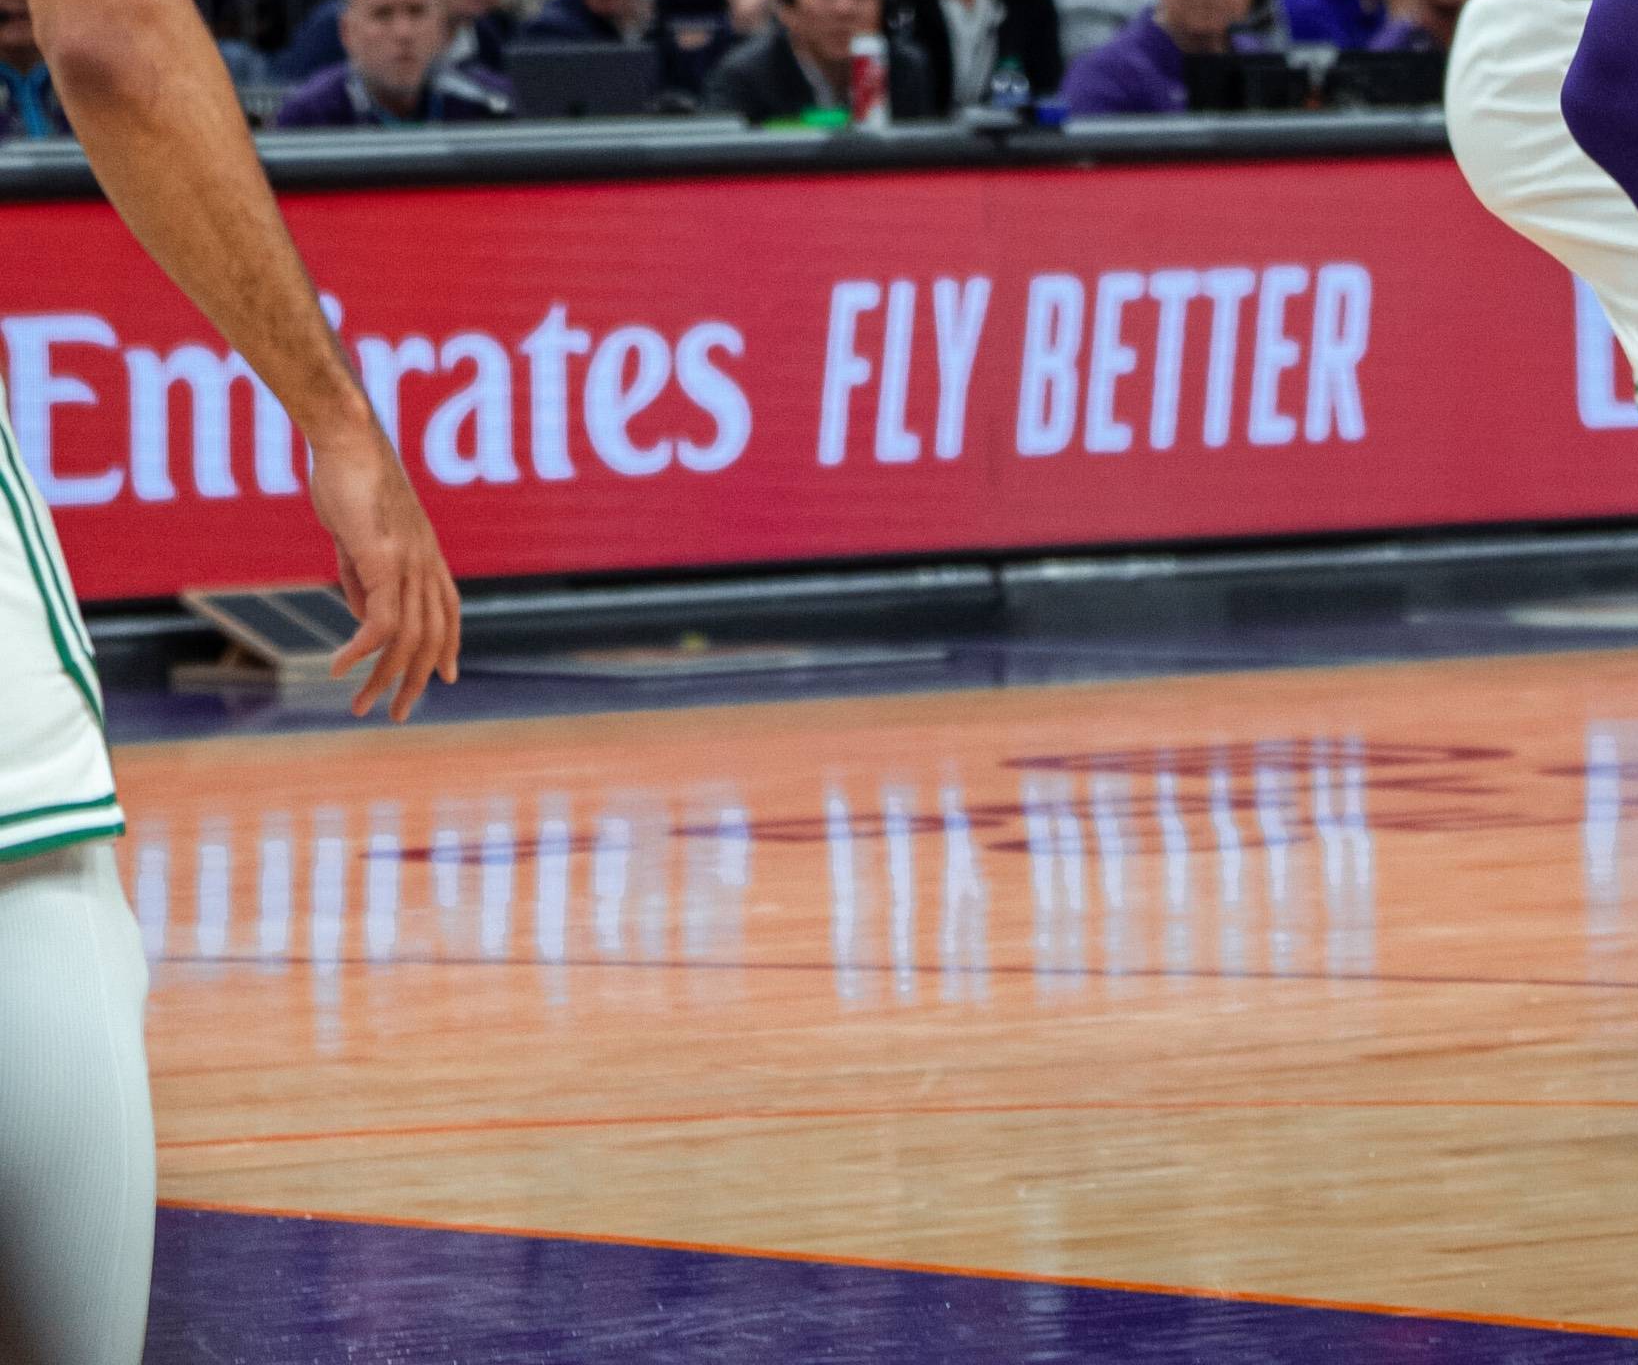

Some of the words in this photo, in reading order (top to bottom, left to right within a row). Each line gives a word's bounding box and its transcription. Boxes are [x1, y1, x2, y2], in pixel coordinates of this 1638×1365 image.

[1, 292, 753, 507] Emrates
[817, 277, 992, 466] FLY
[1014, 262, 1372, 457] BETTER
